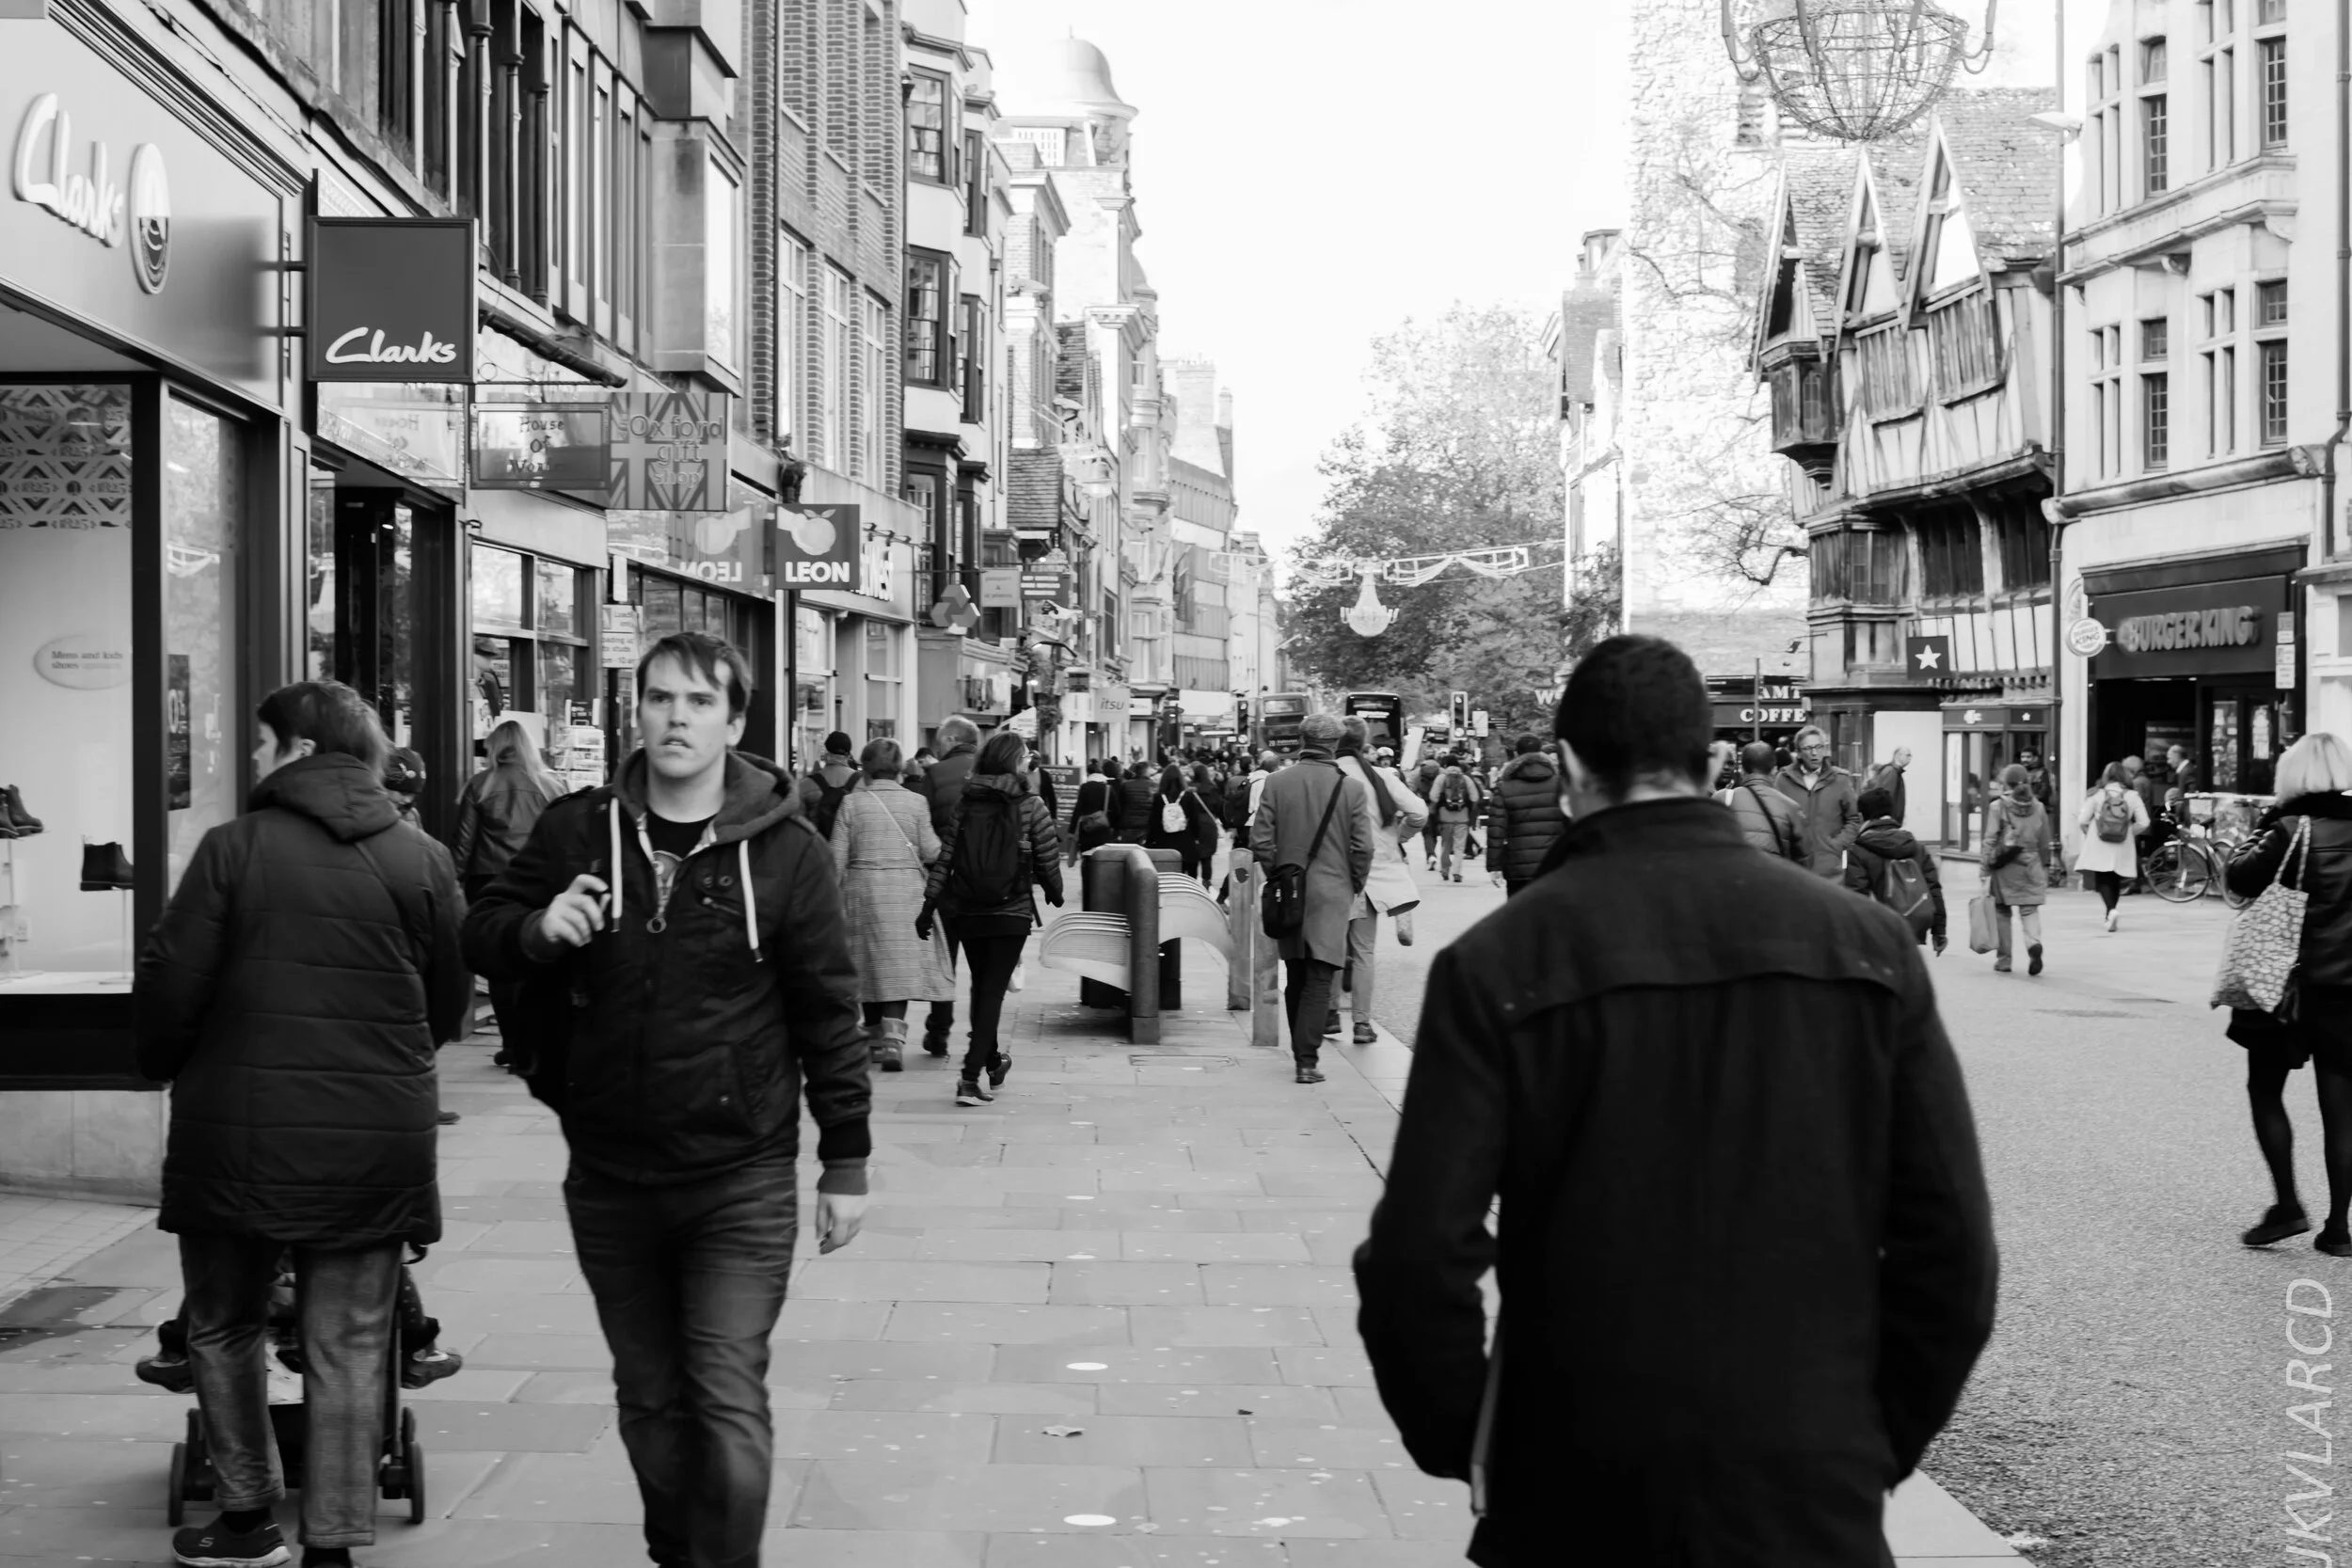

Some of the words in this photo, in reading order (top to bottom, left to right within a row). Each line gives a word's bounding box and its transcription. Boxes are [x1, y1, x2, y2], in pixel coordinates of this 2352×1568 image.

[12, 92, 124, 247] Clarks
[326, 326, 456, 363] Clarks
[519, 416, 564, 433] House
[629, 414, 723, 438] Oxford
[658, 438, 703, 467] gift
[653, 468, 701, 490] shop
[785, 562, 850, 583] LEON
[2126, 612, 2201, 652] BURGER
[2201, 606, 2259, 647] KING
[1100, 698, 1124, 710] itsu
[1740, 708, 1806, 722] COFFE
